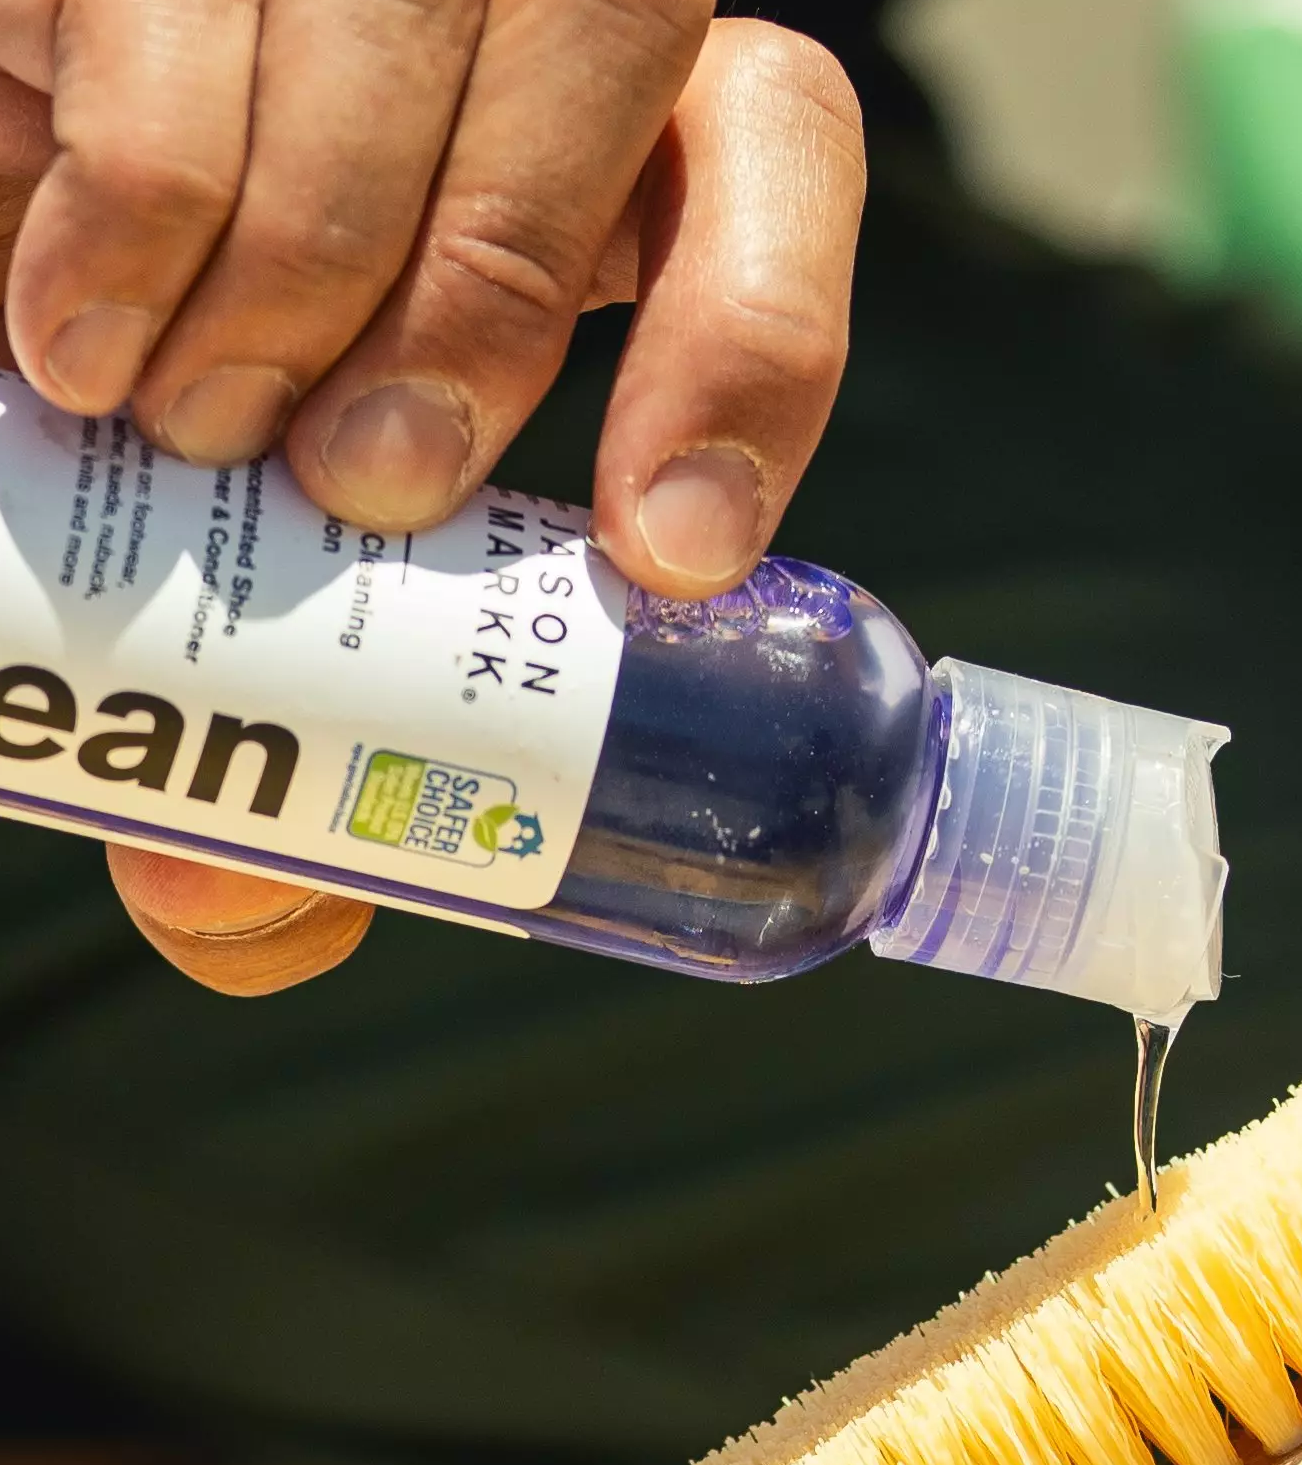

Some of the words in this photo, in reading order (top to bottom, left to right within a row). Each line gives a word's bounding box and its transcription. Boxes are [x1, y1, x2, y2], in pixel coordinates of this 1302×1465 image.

[70, 493, 90, 533] and
[212, 505, 231, 522] &
[59, 534, 83, 587] more
[185, 527, 230, 665] Conditioner
[338, 531, 386, 651] Cleaning
[223, 574, 254, 637] Shoe
[521, 518, 578, 695] JASON
[404, 768, 450, 851] CHOICE
[431, 774, 480, 855] SAFER
